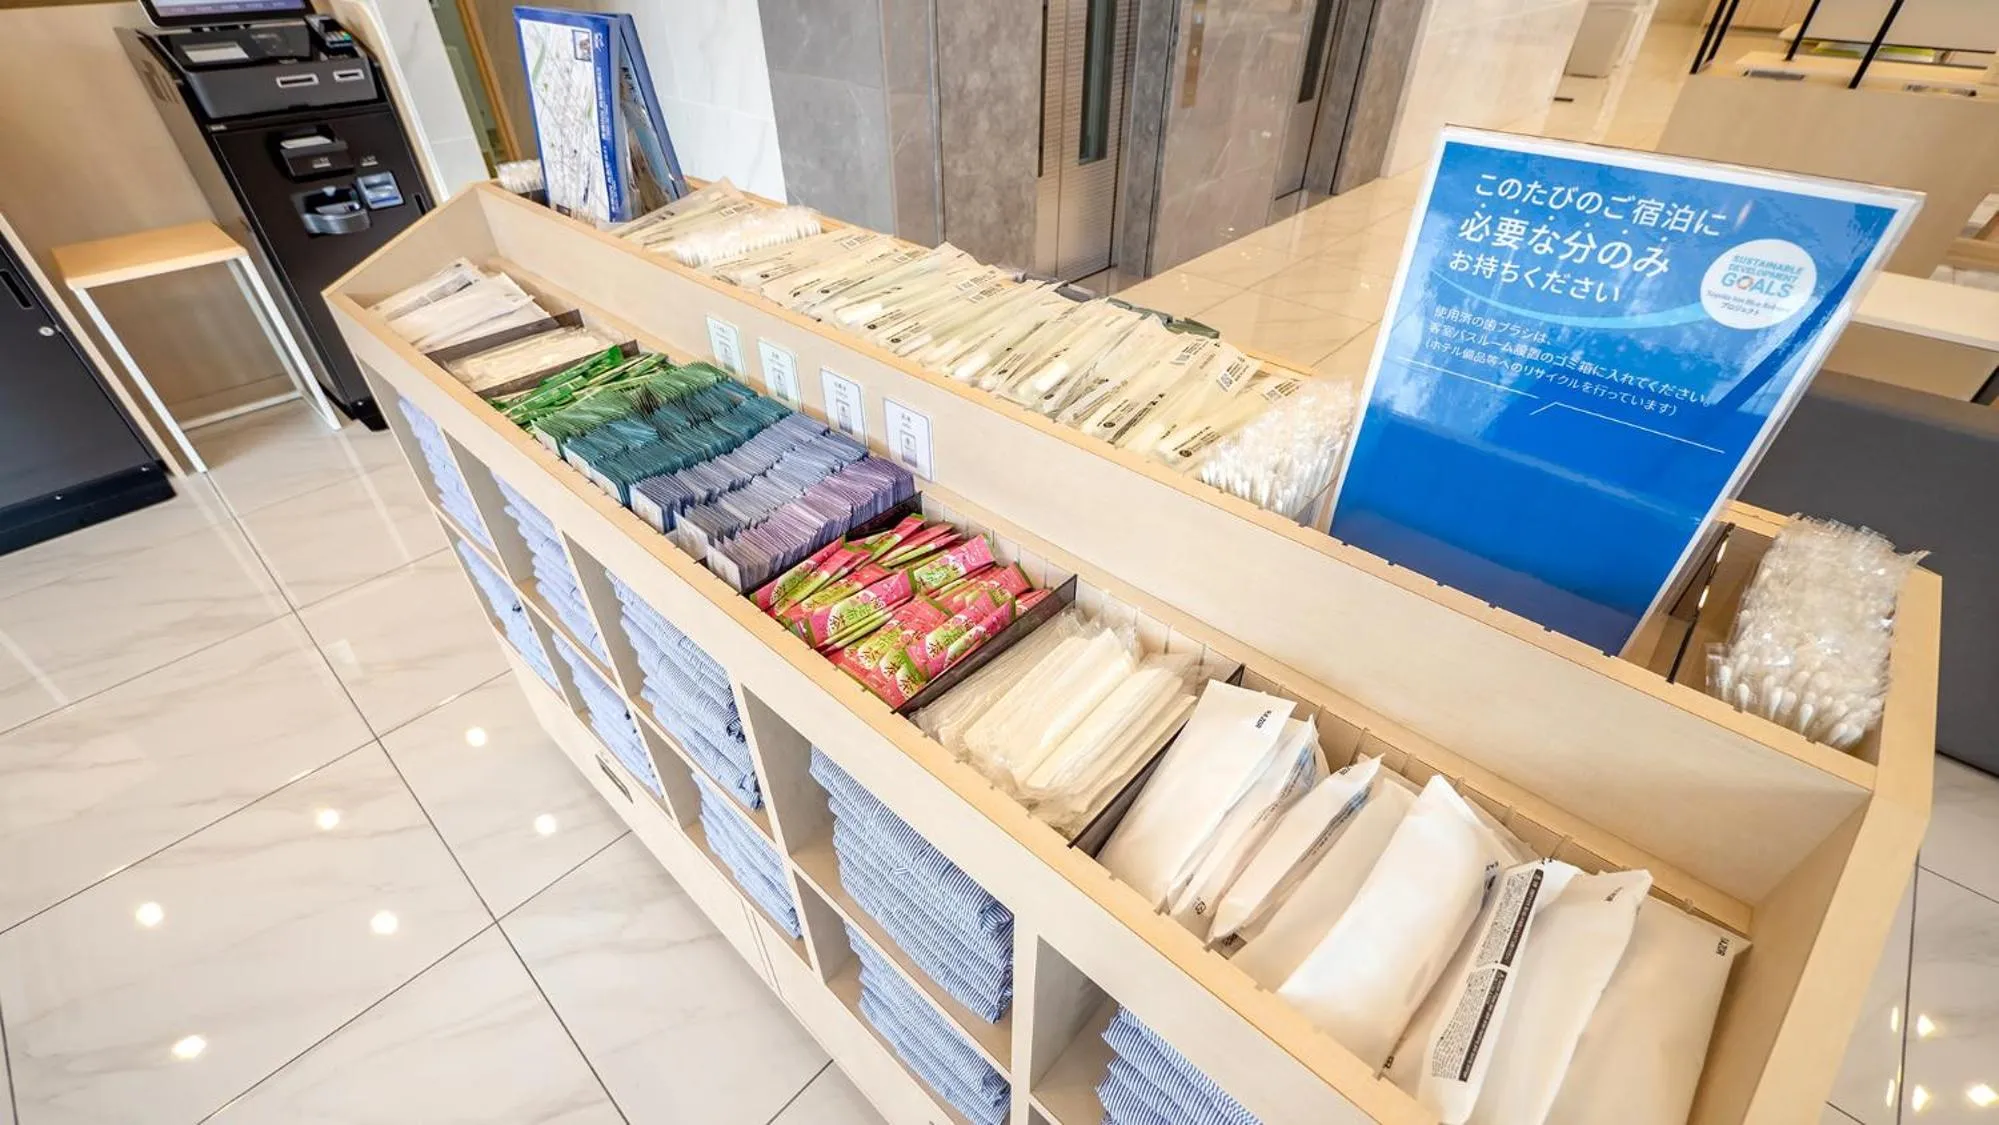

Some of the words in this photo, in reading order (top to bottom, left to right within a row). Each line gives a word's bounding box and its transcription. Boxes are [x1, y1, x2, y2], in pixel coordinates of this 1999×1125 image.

[1475, 173, 1727, 237] このたびのご宿泊に
[1458, 210, 1672, 279] 必要な分のみ
[1448, 249, 1622, 304] お持ちください
[1721, 272, 1793, 298] GOALS
[1727, 263, 1799, 283] DEVELOPMENT
[1732, 255, 1805, 275] SUSTAINABLE
